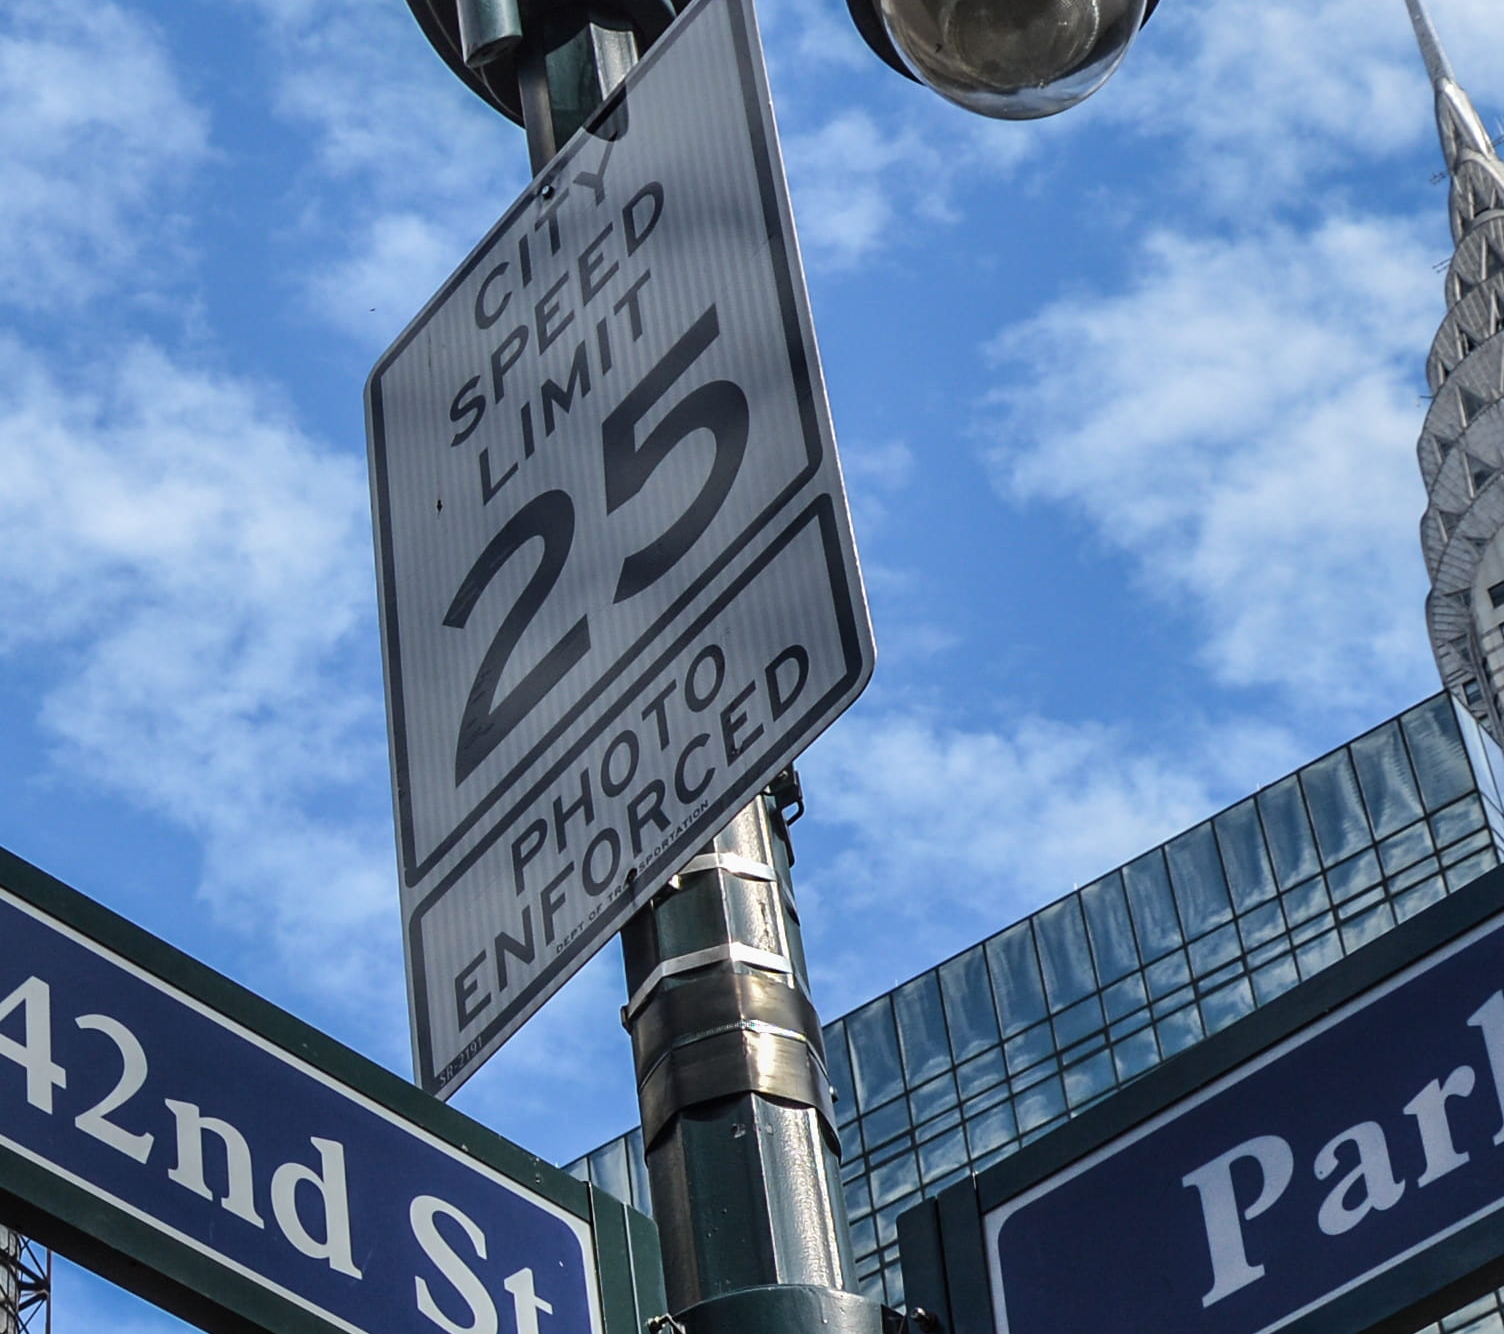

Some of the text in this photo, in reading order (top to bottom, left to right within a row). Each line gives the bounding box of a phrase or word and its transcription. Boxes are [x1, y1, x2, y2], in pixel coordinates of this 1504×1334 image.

[450, 181, 665, 447] SPEED
[475, 130, 619, 330] CITY
[479, 269, 651, 505] LIMIT
[442, 303, 750, 788] 25
[454, 644, 810, 1033] ENFORCED
[511, 644, 726, 896] PHOTO
[556, 921, 585, 954] DEPT
